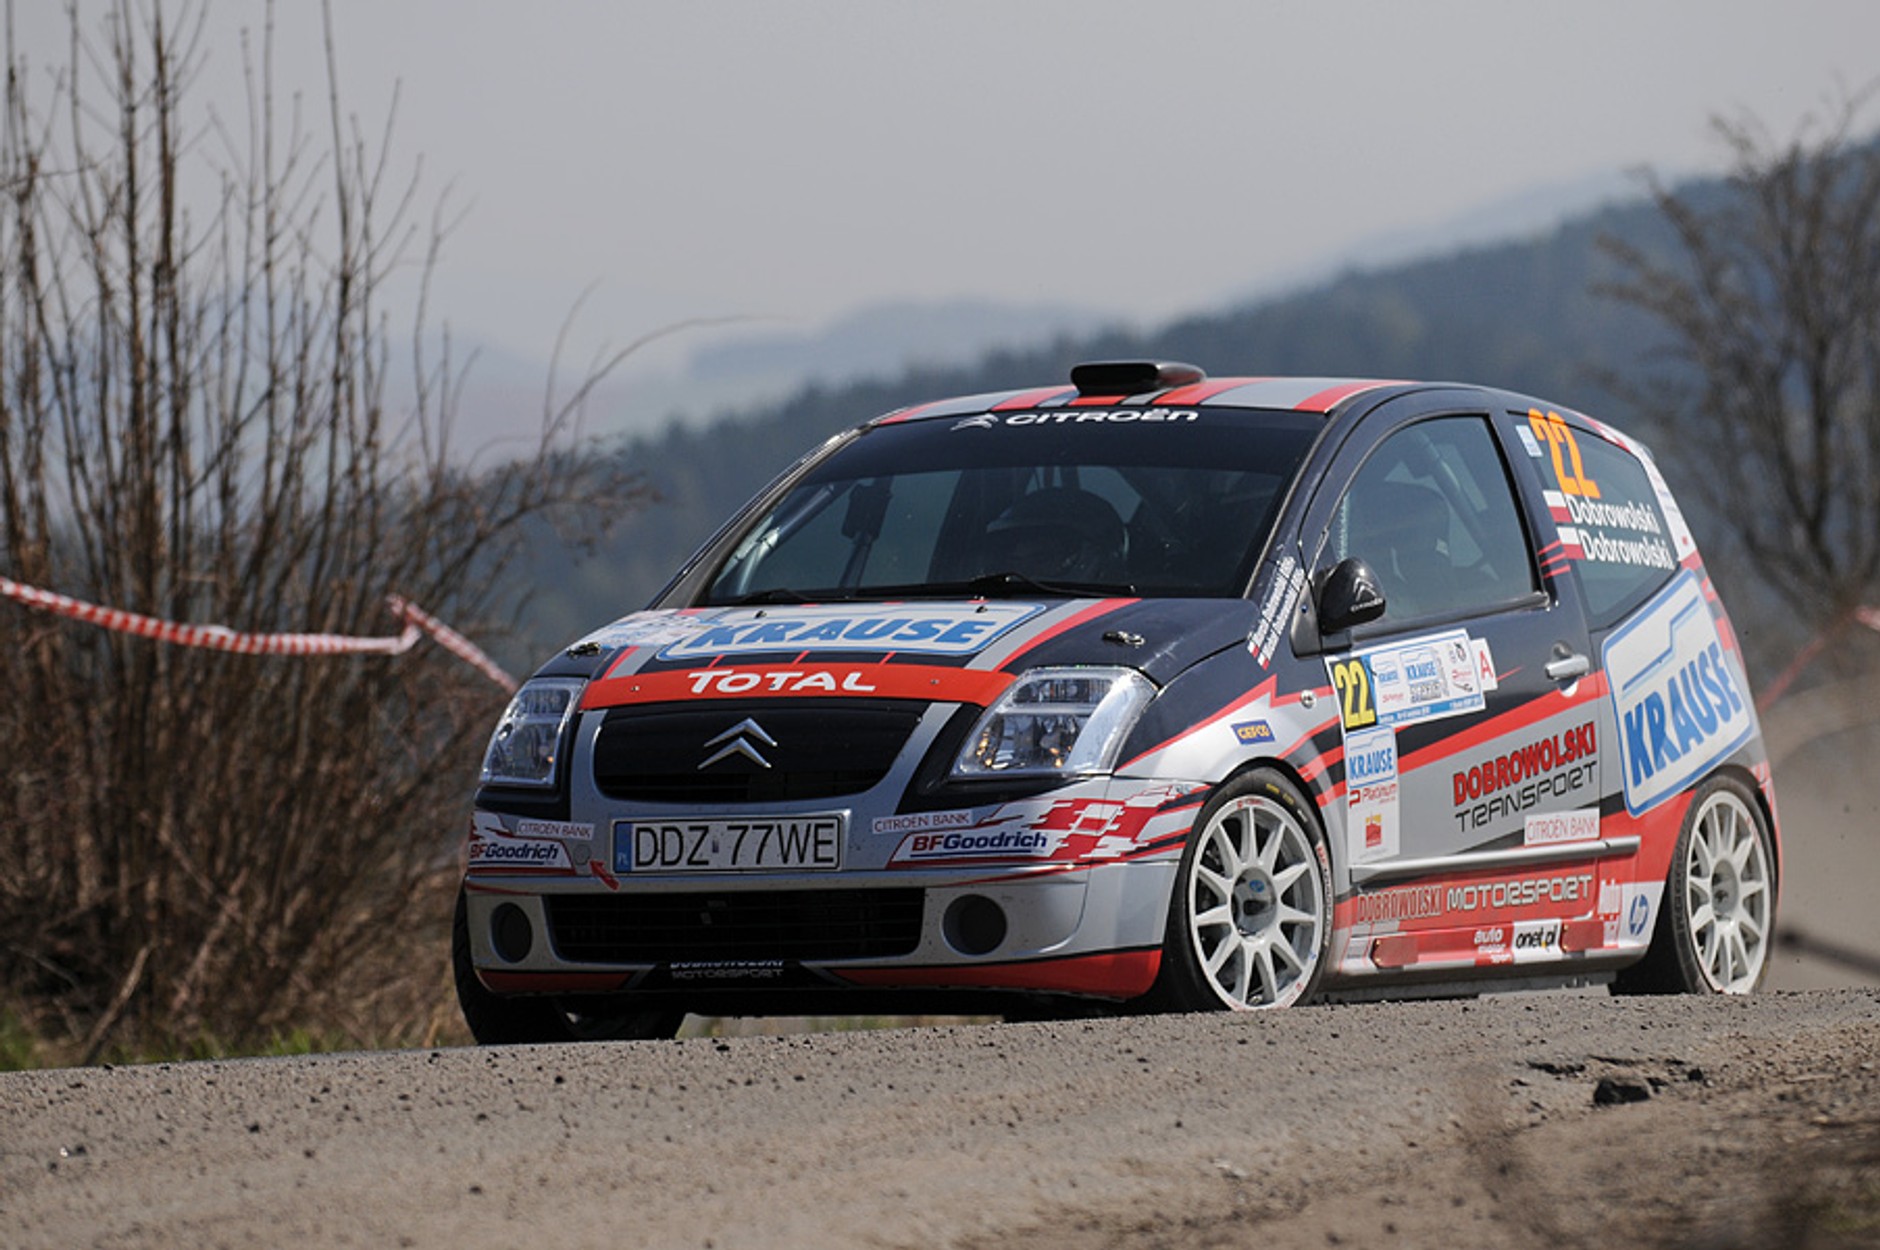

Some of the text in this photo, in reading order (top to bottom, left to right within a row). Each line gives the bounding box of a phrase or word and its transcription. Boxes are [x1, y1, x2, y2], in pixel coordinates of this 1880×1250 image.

[1528, 408, 1601, 498] 22
[1564, 494, 1661, 535] Dobrowolski
[1578, 528, 1676, 571] Dobrowolski
[684, 618, 998, 649] KRAUSE
[688, 669, 877, 694] TOTAL
[1479, 650, 1494, 680] A
[1334, 660, 1376, 729] 22
[1624, 641, 1743, 788] KRAUSE
[1349, 747, 1393, 780] KRAUSE
[1453, 721, 1597, 806] DOBROWOLSKI
[1454, 761, 1598, 832] TRANSPORT
[932, 813, 969, 827] BANK
[1571, 816, 1598, 837] BANK
[470, 843, 559, 860] BFGoodrich
[635, 821, 835, 866] DDZ 77WE
[912, 831, 1047, 851] BFGoodrich
[1357, 875, 1593, 924] DOBROWOLSKI MOTORSPORT
[1474, 927, 1504, 945] auto
[1516, 924, 1559, 952] onet.pl
